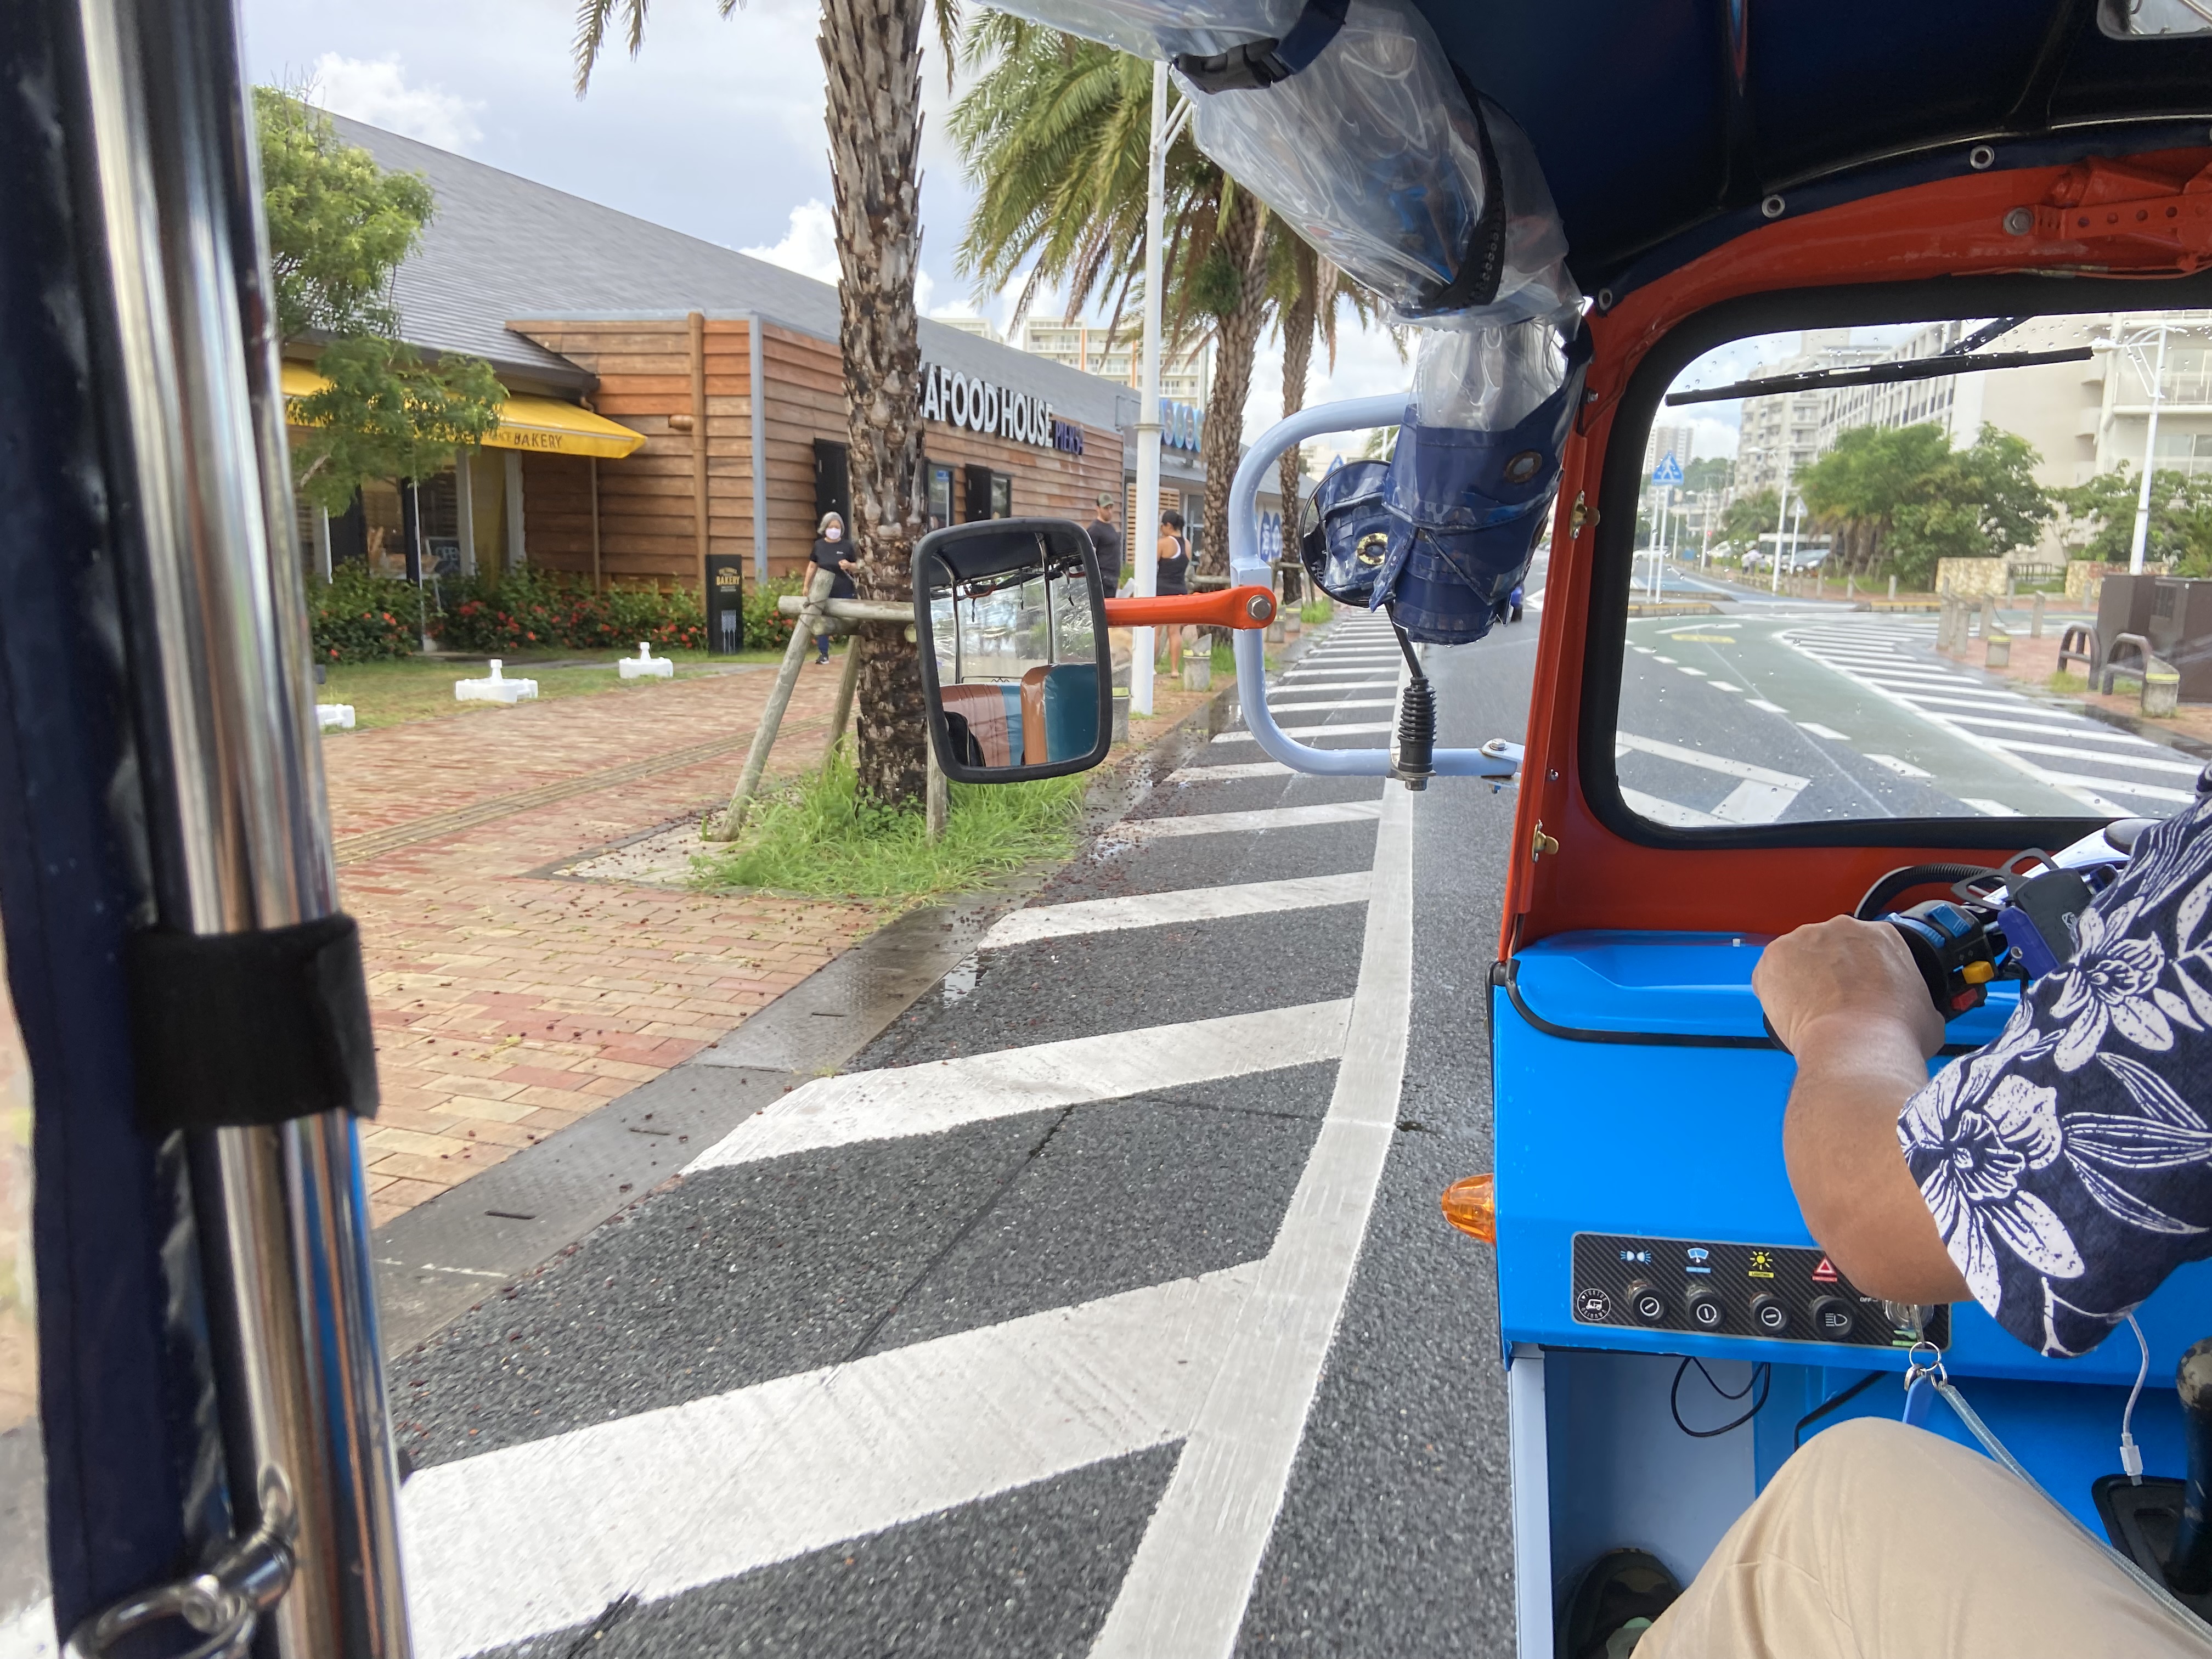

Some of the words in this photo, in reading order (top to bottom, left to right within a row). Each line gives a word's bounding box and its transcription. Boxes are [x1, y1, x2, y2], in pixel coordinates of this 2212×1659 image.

[1000, 387, 1053, 448] HOUSE
[514, 432, 562, 448] BAKERY
[716, 575, 740, 585] BAKERY
